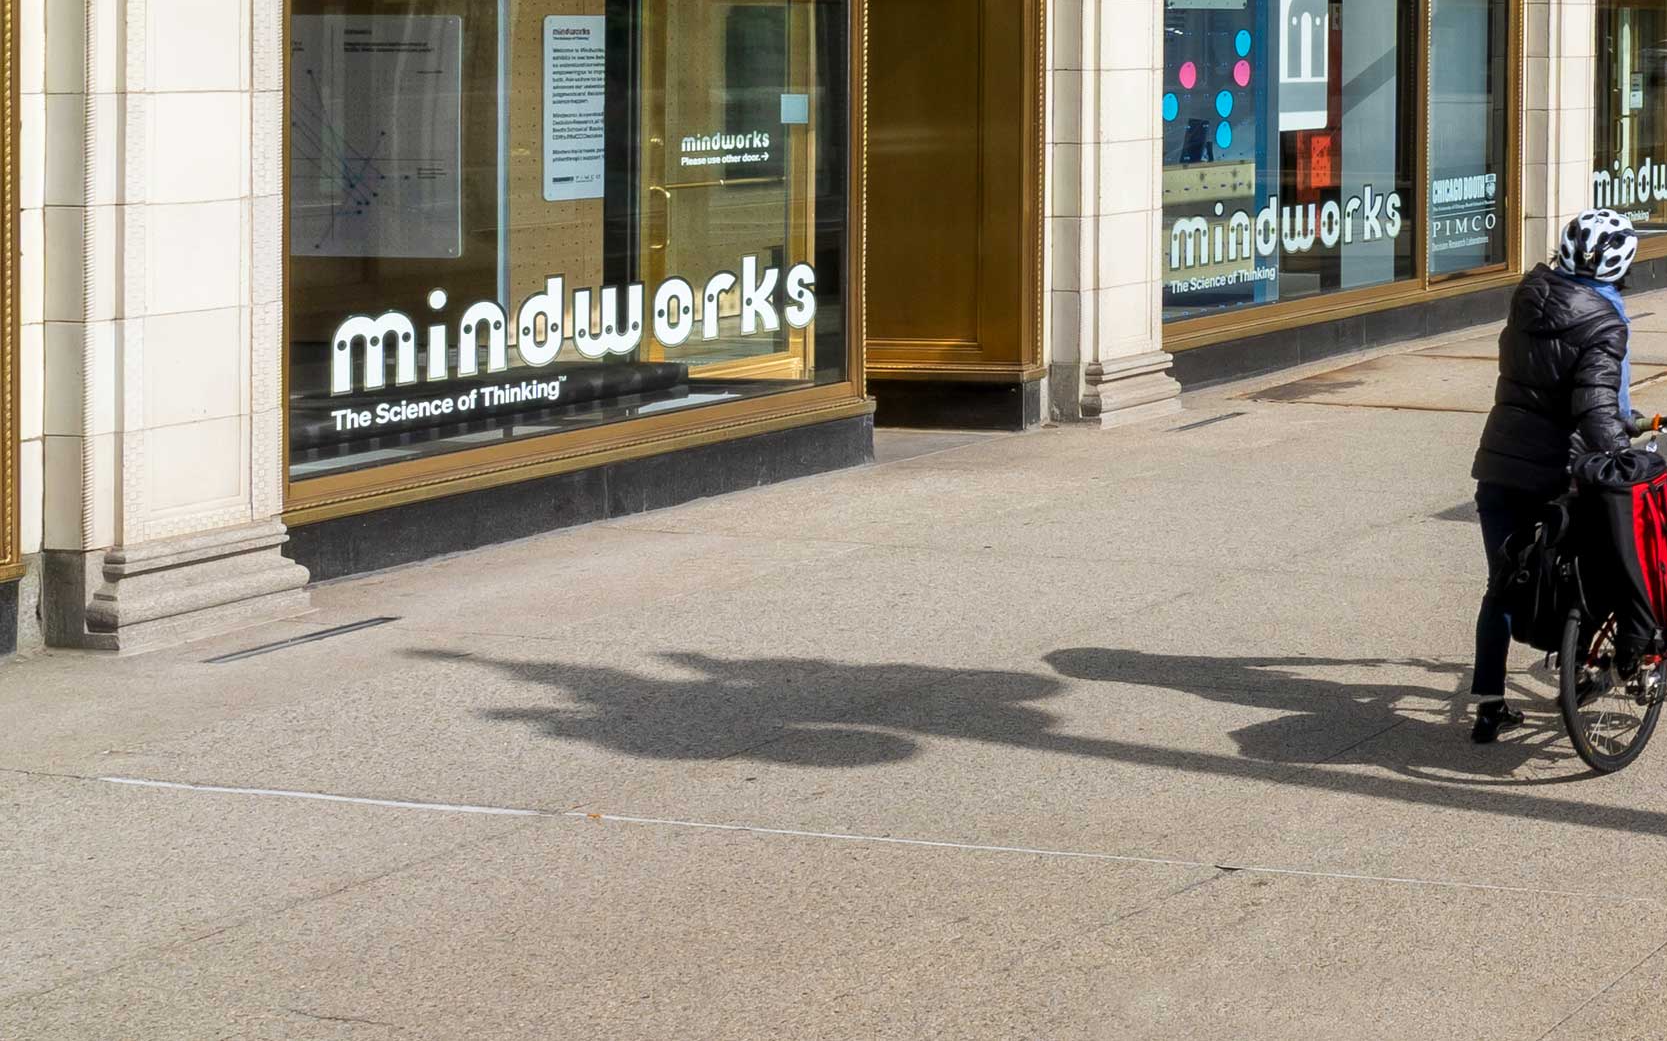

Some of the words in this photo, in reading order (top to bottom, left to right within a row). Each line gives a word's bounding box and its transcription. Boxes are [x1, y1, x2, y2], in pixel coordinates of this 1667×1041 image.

[681, 130, 770, 151] mindworks
[681, 157, 706, 166] Please
[707, 156, 720, 164] use
[722, 154, 740, 163] other
[742, 153, 760, 162] door.
[1169, 184, 1401, 270] mindworks
[1433, 213, 1496, 237] PIMCO
[1171, 279, 1189, 294] The
[1190, 274, 1226, 291] Science
[1227, 271, 1238, 285] of
[330, 255, 816, 396] mindworks
[331, 408, 372, 431] The
[375, 398, 453, 425] Science
[457, 389, 478, 411] of
